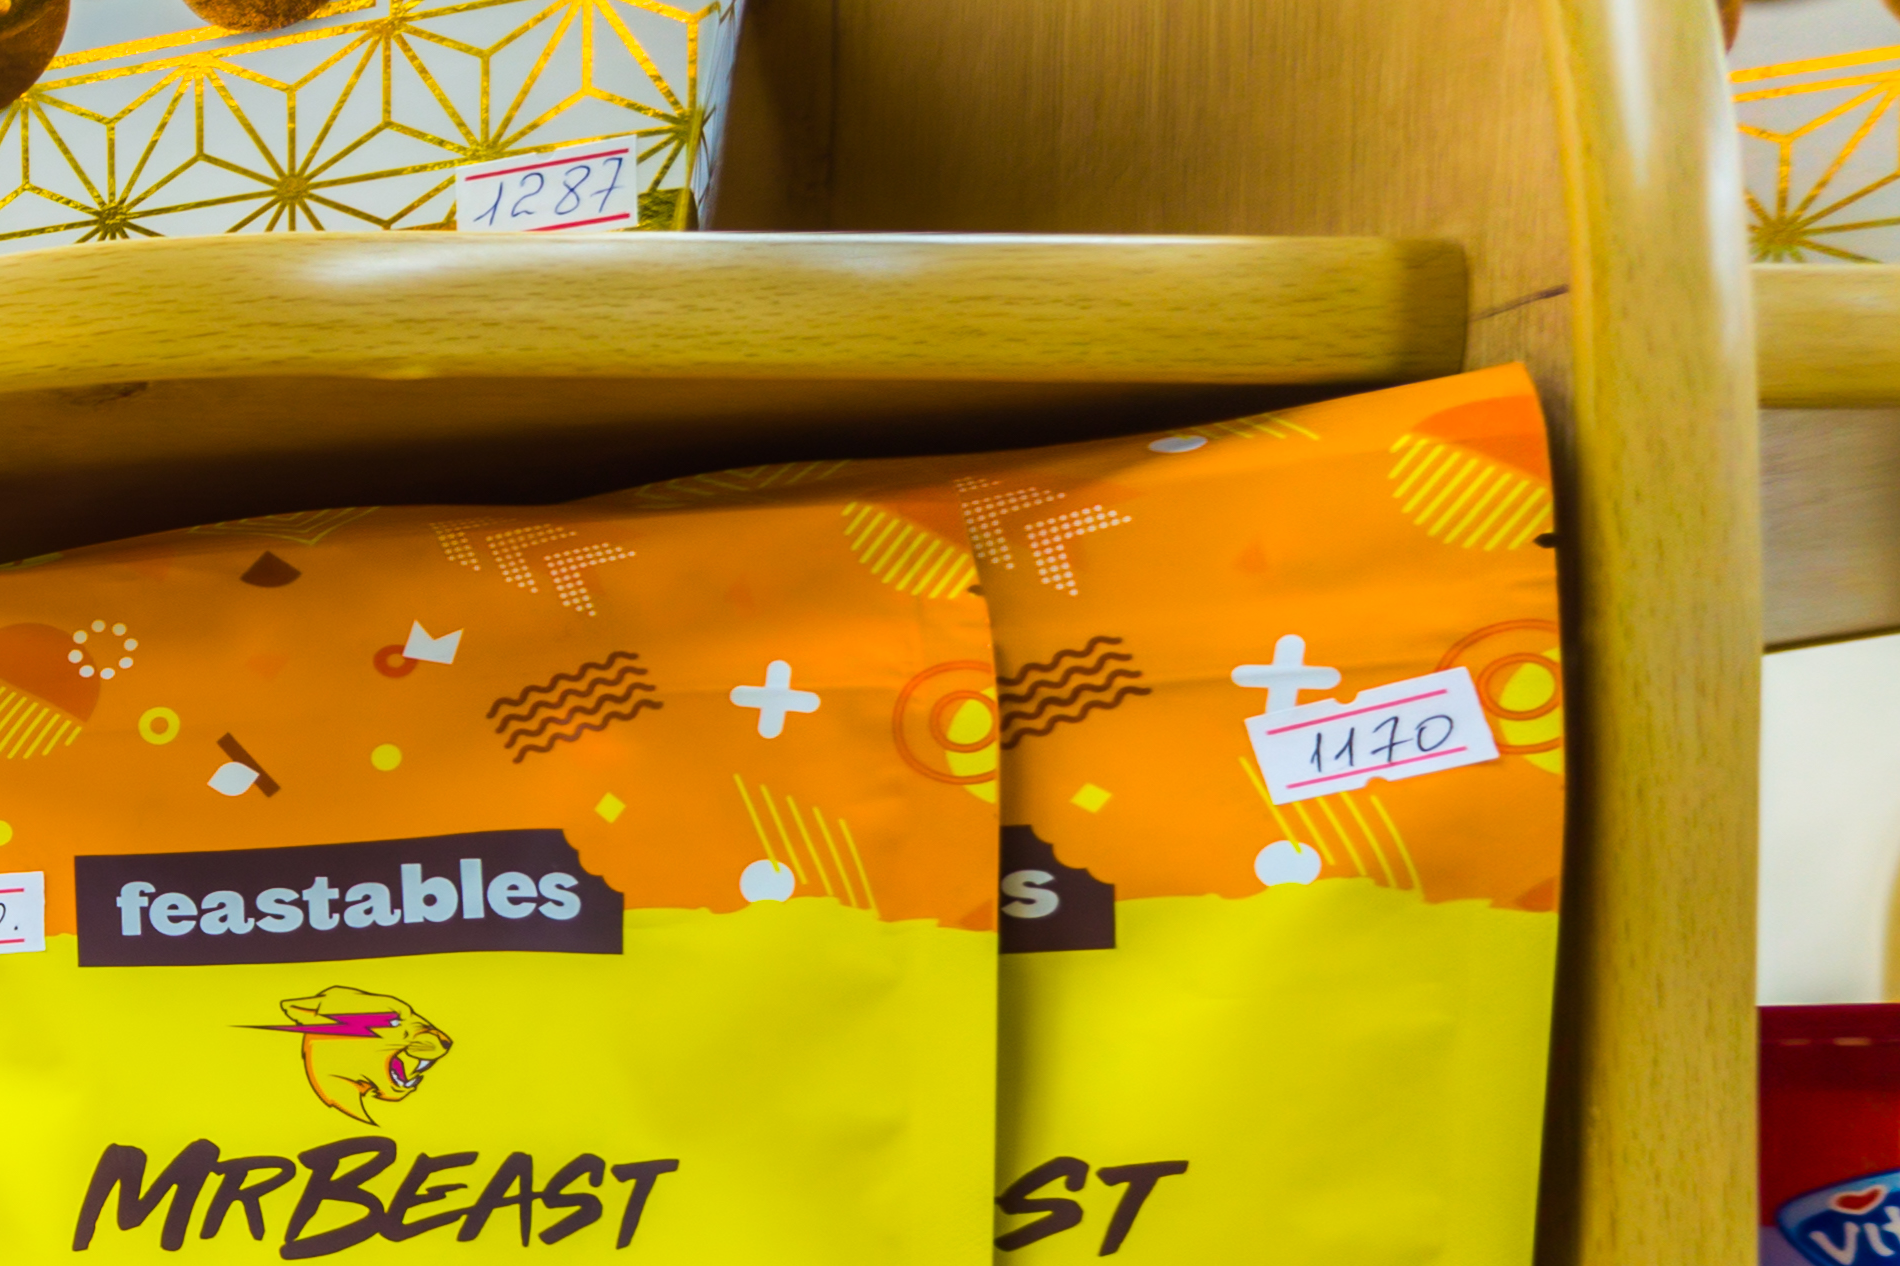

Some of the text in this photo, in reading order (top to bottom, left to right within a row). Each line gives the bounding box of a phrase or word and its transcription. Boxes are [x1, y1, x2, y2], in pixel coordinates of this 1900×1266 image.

[473, 157, 624, 226] 1287
[1309, 714, 1455, 774] 1170
[116, 858, 583, 937] feastables
